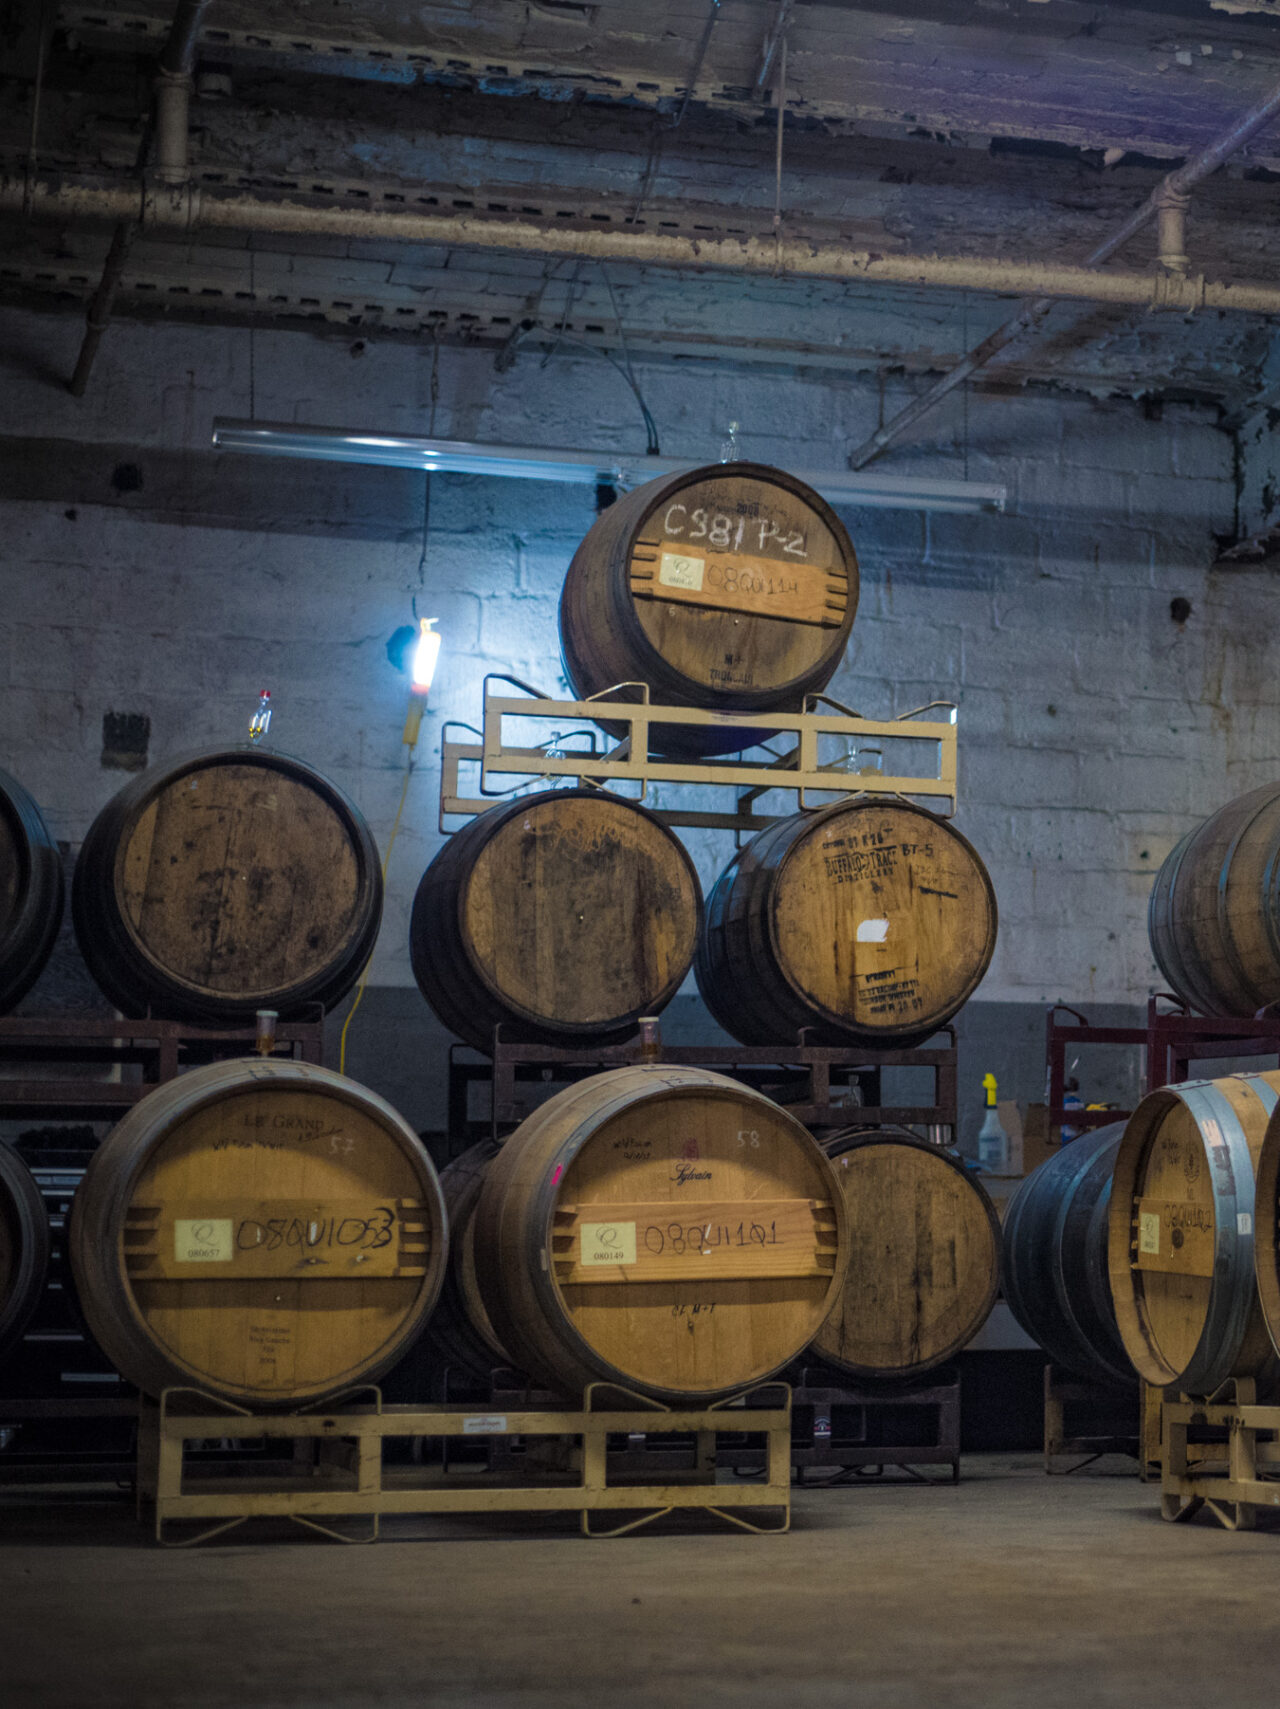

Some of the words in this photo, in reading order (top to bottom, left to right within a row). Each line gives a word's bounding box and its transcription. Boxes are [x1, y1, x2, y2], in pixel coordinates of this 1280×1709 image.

[824, 854, 863, 877] BUFFALO
[272, 1114, 325, 1130] GRAND
[736, 1130, 761, 1148] 58
[669, 1163, 713, 1186] Sylvain
